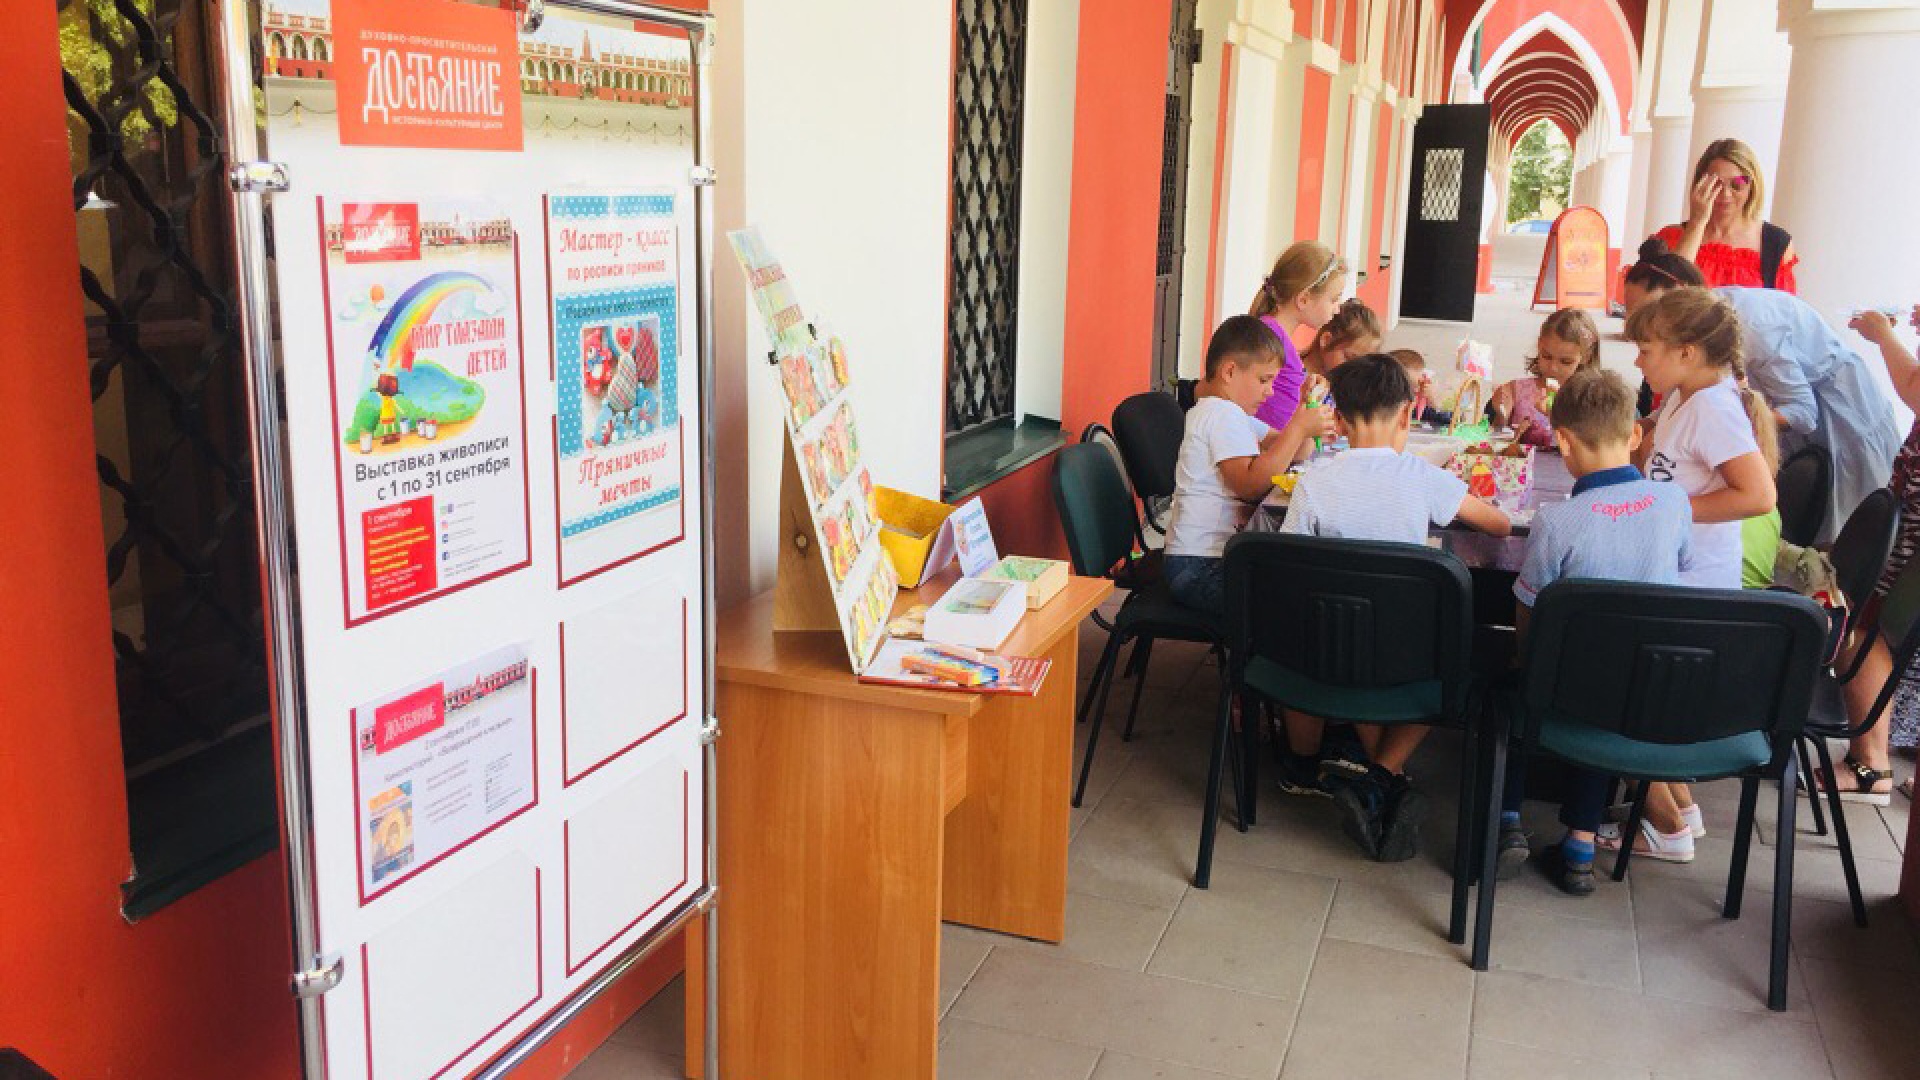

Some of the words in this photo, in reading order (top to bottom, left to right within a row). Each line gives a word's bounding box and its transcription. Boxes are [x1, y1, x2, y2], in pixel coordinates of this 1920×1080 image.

[567, 267, 581, 281] по
[446, 317, 505, 347] ГЛАЗАМИ
[467, 343, 507, 377] ДЕТЕЙ
[355, 453, 435, 482] Выставка
[439, 435, 509, 463] живописи
[390, 479, 397, 497] 1
[401, 478, 422, 495] по
[426, 470, 441, 489] 31
[445, 456, 511, 485] сентября
